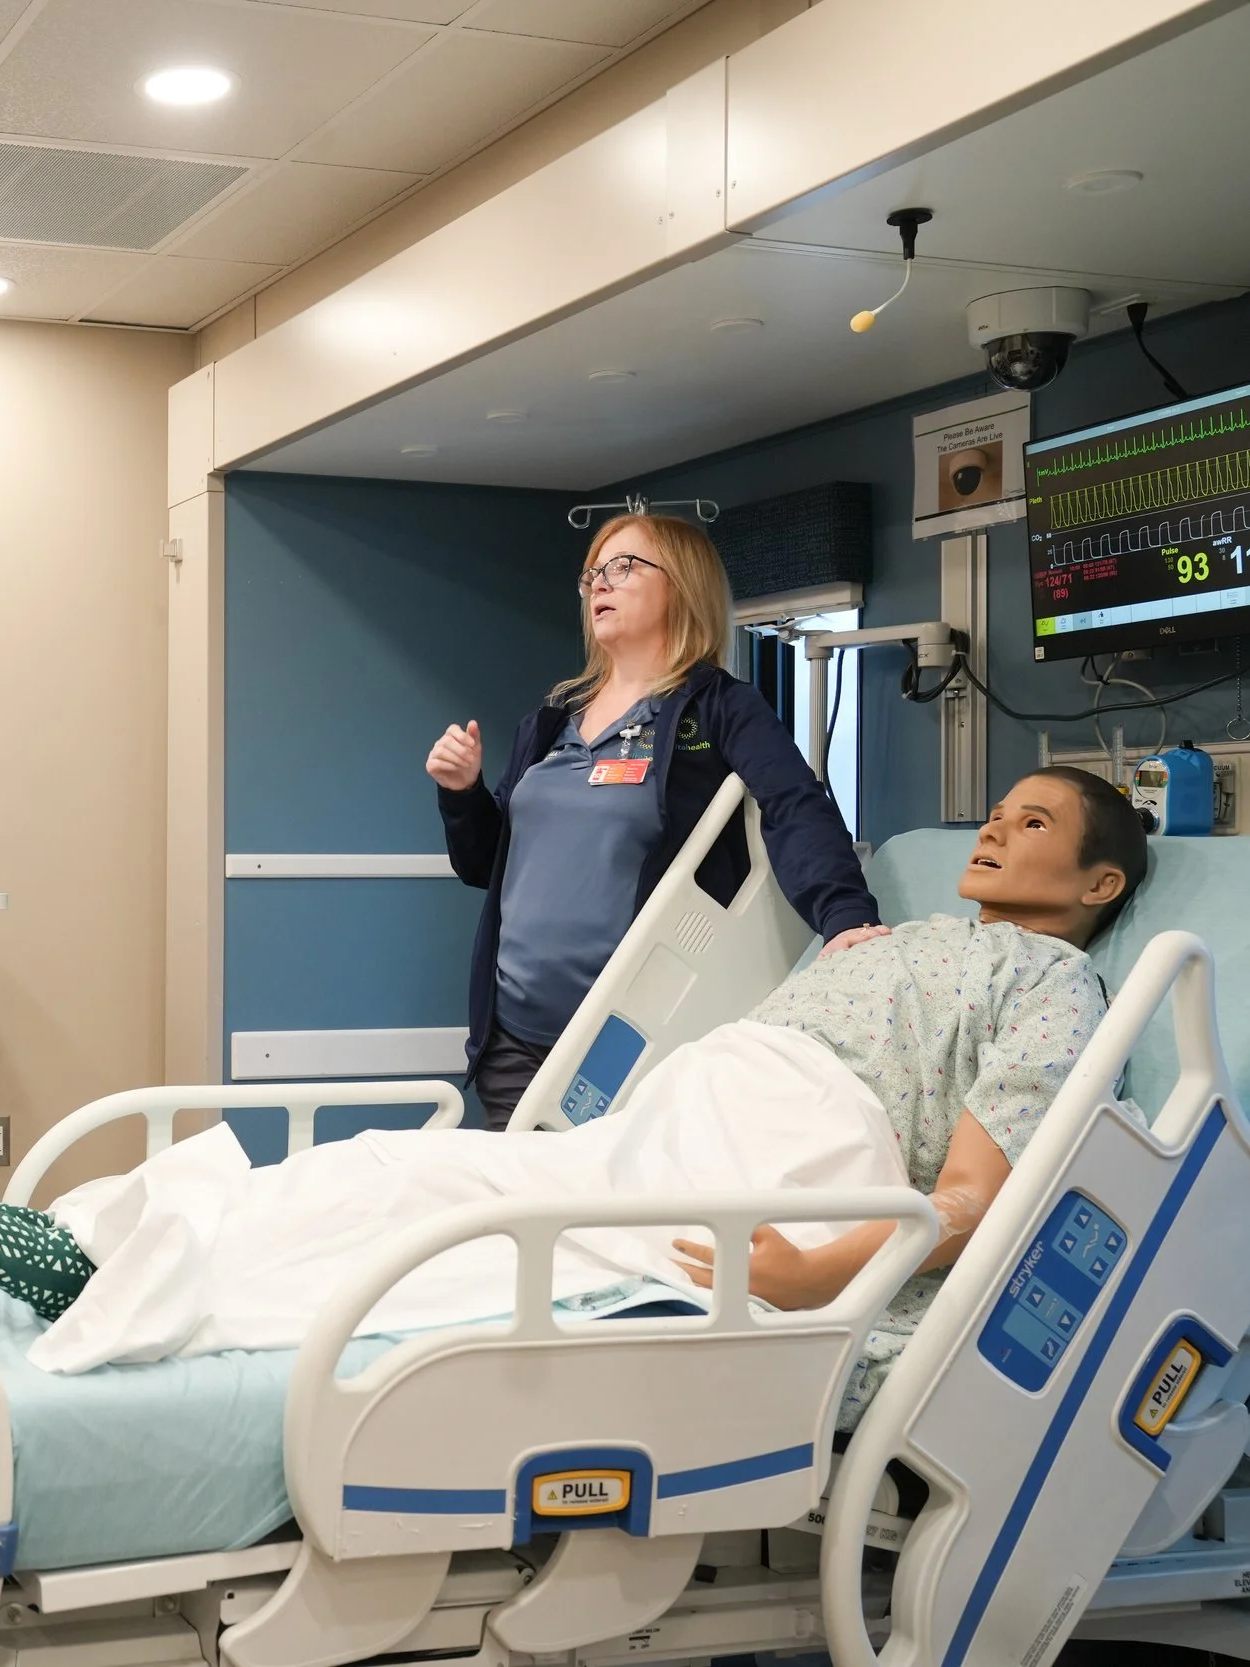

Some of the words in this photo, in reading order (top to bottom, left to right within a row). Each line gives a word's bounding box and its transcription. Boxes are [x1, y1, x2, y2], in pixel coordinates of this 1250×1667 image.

[943, 431, 964, 442] Please
[964, 427, 974, 436] Be
[975, 422, 995, 434] Aware
[937, 444, 948, 453] The
[948, 438, 976, 451] Cameras
[976, 434, 988, 444] Are
[989, 431, 1003, 442] Live
[1212, 536, 1232, 547] awRR
[1161, 547, 1179, 556] Pulse
[1177, 552, 1210, 584] 93
[1045, 573, 1073, 588] 124/71
[1052, 588, 1069, 600] (89)
[1159, 625, 1177, 635] DELL
[1008, 1240, 1043, 1299] stryker
[1151, 1362, 1184, 1406] PULL
[562, 1482, 609, 1499] PULL
